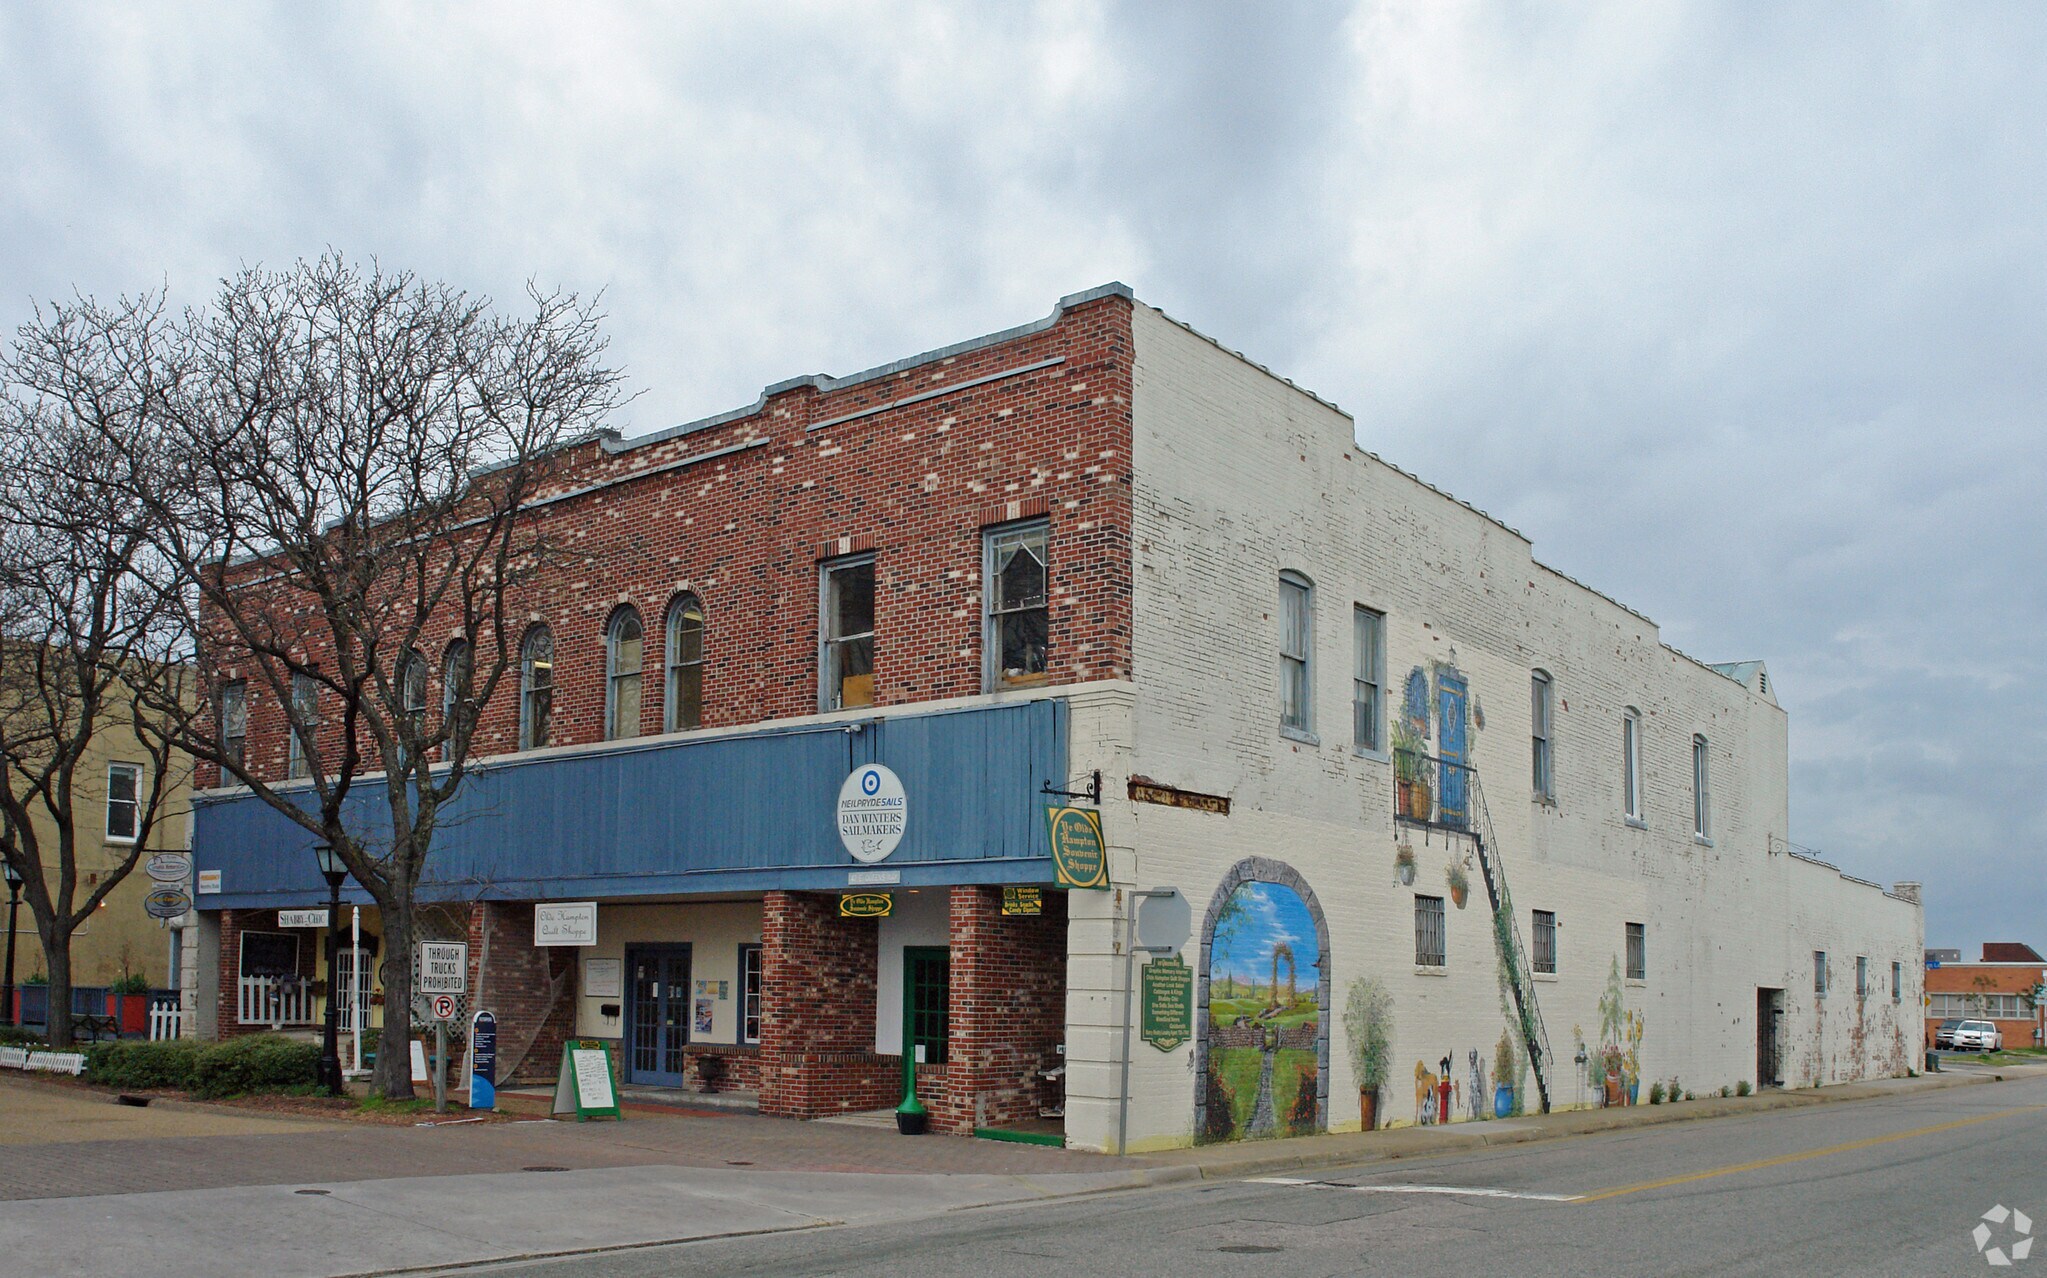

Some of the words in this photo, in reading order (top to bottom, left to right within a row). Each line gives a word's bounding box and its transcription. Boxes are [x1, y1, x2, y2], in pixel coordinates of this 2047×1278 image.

[842, 814, 860, 824] DAN
[861, 813, 902, 823] WINTERS
[842, 824, 902, 836] SAILMAKERS
[1060, 821, 1073, 833] Ye
[1073, 821, 1093, 833] Olde
[1060, 832, 1096, 847] Hampton
[1063, 845, 1098, 858] Souvenir
[1067, 858, 1097, 872] Shoppe
[540, 911, 555, 921] Olde
[557, 910, 589, 922] Hampton
[542, 925, 559, 935] Quilt
[561, 924, 587, 938] Shoppe
[428, 947, 460, 960] THROUGH
[430, 962, 457, 975] TRUCKS
[423, 976, 463, 989] PROHIBITED
